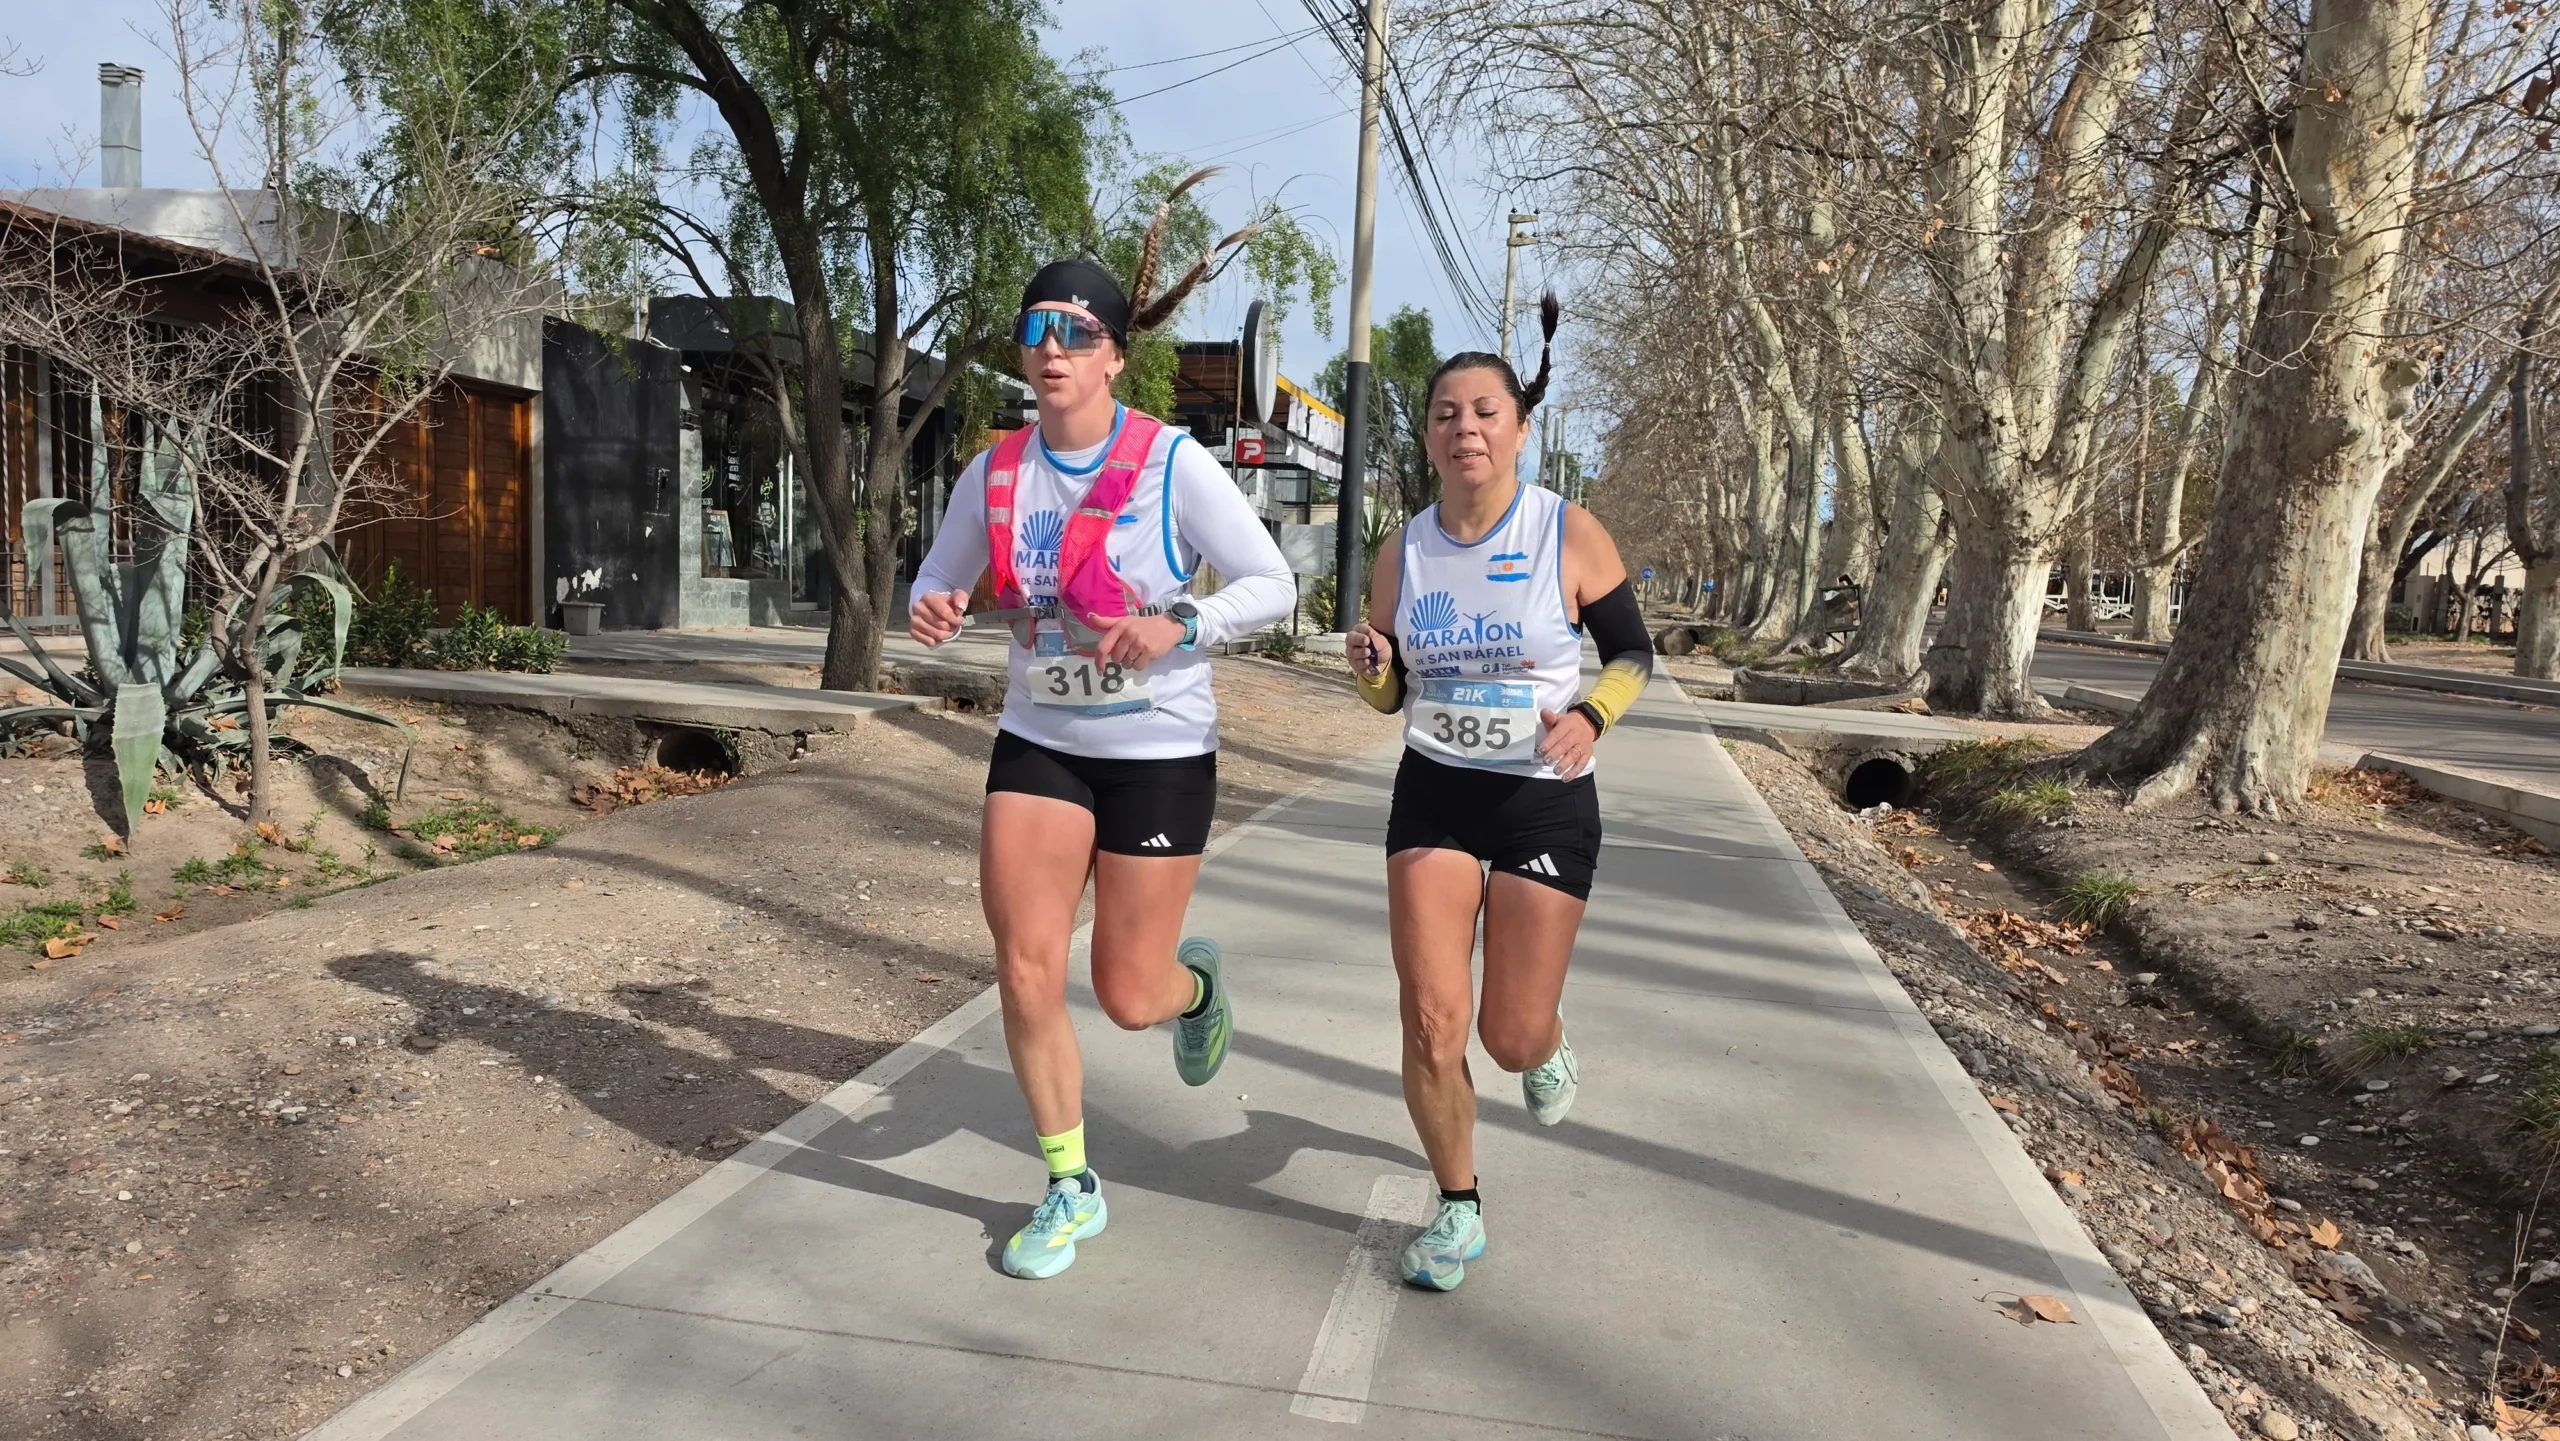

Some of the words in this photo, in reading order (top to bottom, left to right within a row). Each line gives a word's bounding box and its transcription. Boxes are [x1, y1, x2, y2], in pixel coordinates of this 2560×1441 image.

[1021, 577, 1031, 585] DE
[1415, 658, 1426, 666] DE
[1427, 651, 1461, 665] SAN
[1463, 646, 1525, 661] RAFAEL
[1045, 662, 1125, 696] 318
[1452, 687, 1488, 703] 21K
[1432, 712, 1511, 750] 385
